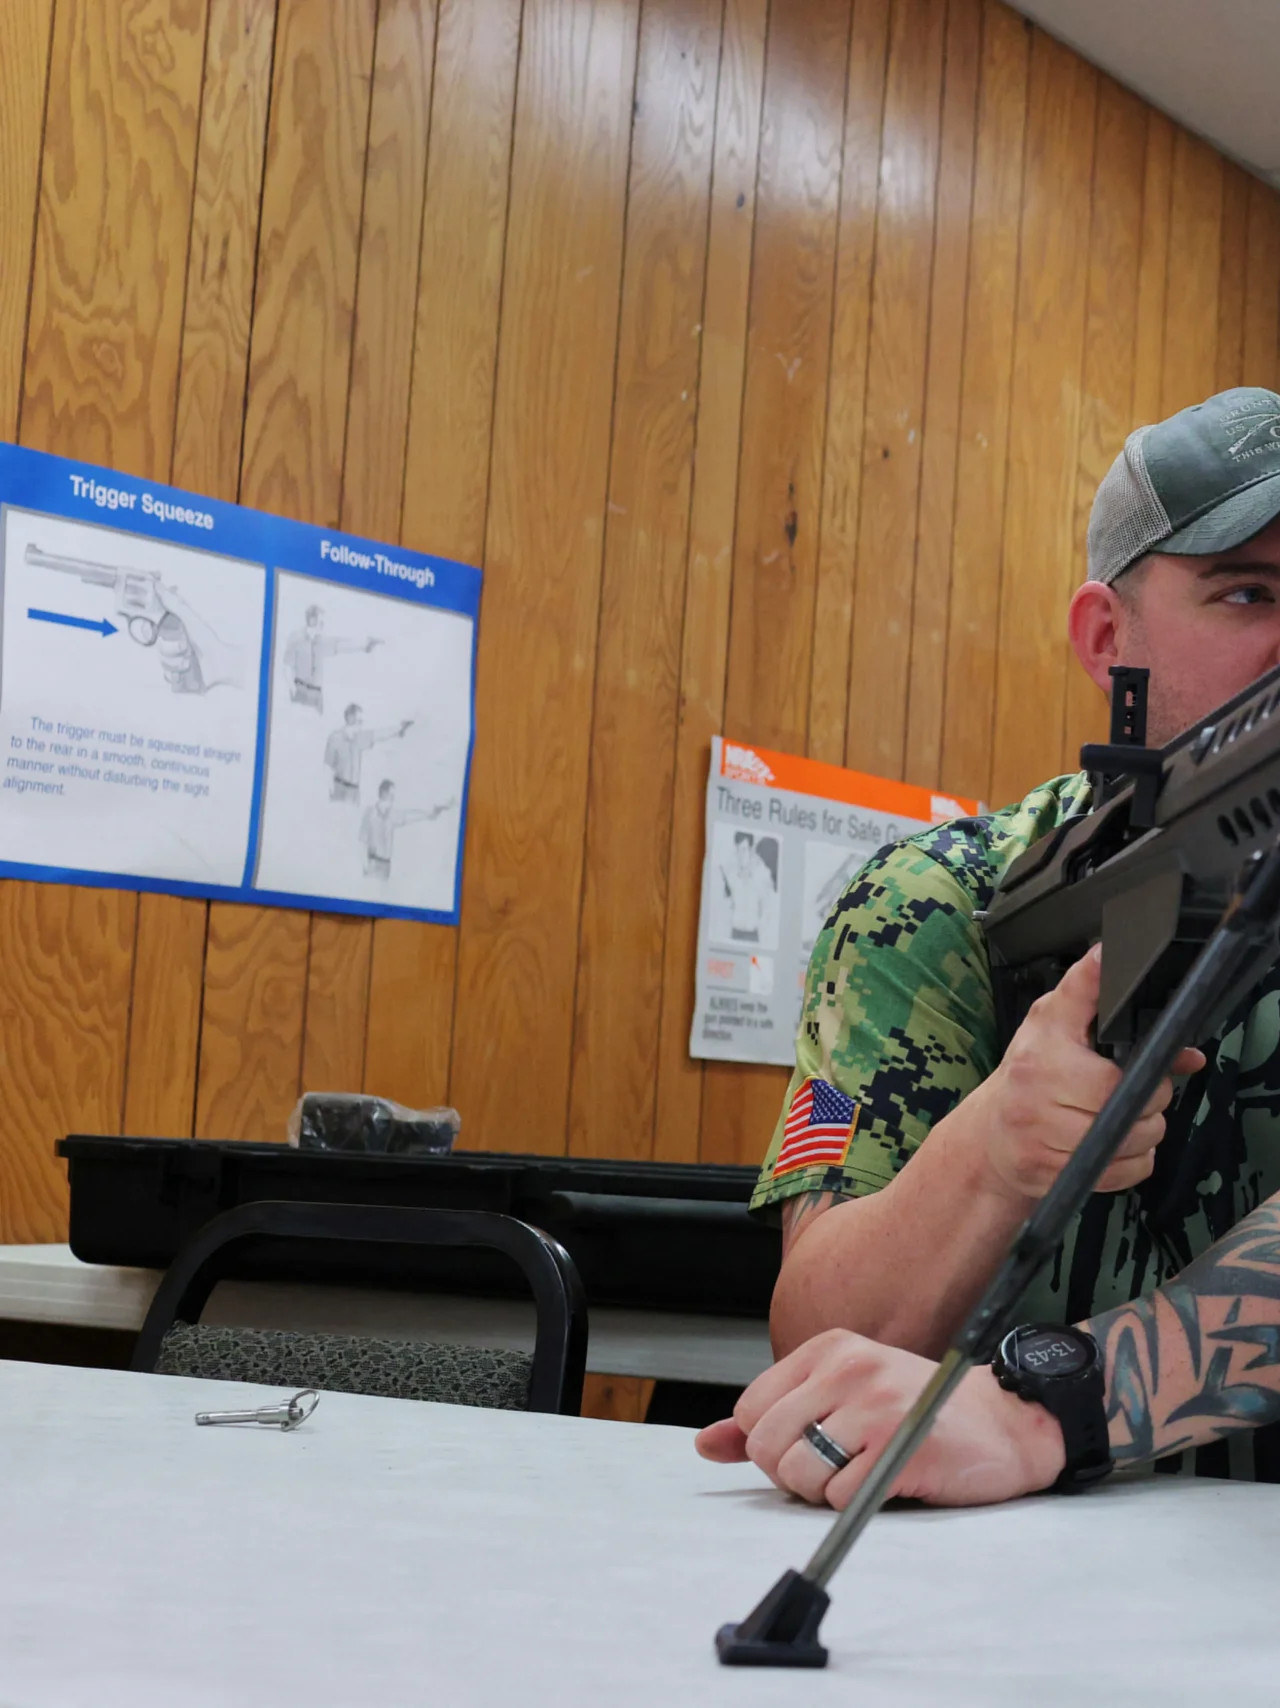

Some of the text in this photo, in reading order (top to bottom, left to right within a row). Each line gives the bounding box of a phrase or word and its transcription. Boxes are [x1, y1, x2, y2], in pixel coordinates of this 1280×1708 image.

[1232, 446, 1263, 463] THIS
[69, 474, 214, 530] Trigger Squeeze
[320, 540, 435, 589] Follow-Through
[10, 735, 22, 749] to
[26, 738, 46, 753] the
[49, 743, 73, 757] rear
[77, 747, 88, 758] in
[90, 750, 98, 761] a
[151, 758, 210, 778] continuous
[31, 716, 242, 765] The trigger must be squeezed straight
[6, 757, 210, 798] manner without disturbing the sight
[716, 786, 763, 820] Three
[768, 798, 817, 832] Rules
[822, 809, 844, 835] for
[847, 814, 882, 844] Safe
[1025, 1341, 1076, 1367] 13:43
